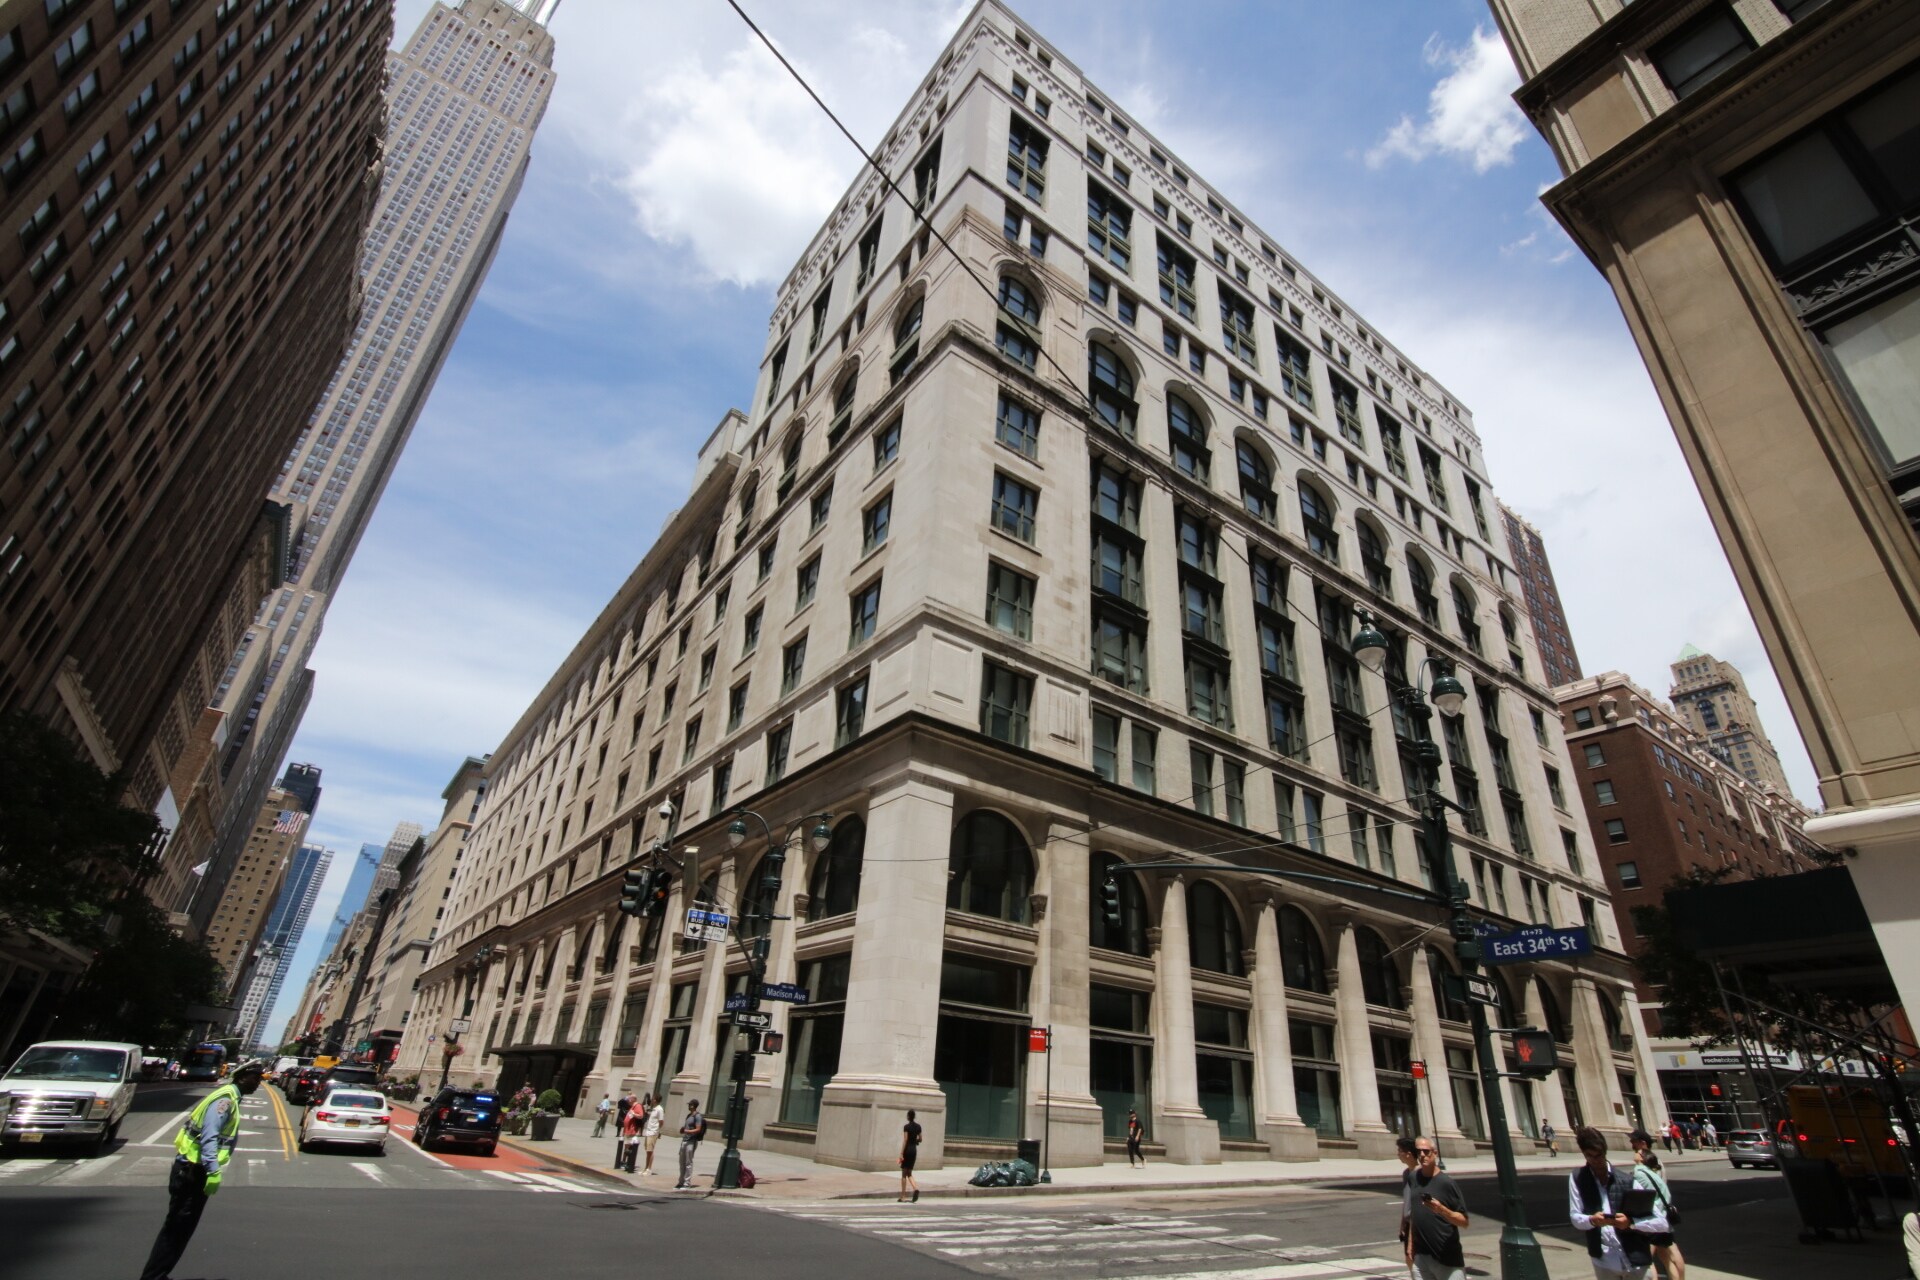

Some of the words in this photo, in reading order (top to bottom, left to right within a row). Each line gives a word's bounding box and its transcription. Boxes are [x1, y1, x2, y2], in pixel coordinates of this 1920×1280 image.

[1493, 940, 1525, 956] East
[1527, 936, 1556, 954] 34th
[1559, 936, 1578, 951] St
[766, 988, 793, 999] Madison
[793, 992, 807, 1001] Ave
[727, 1000, 735, 1008] East
